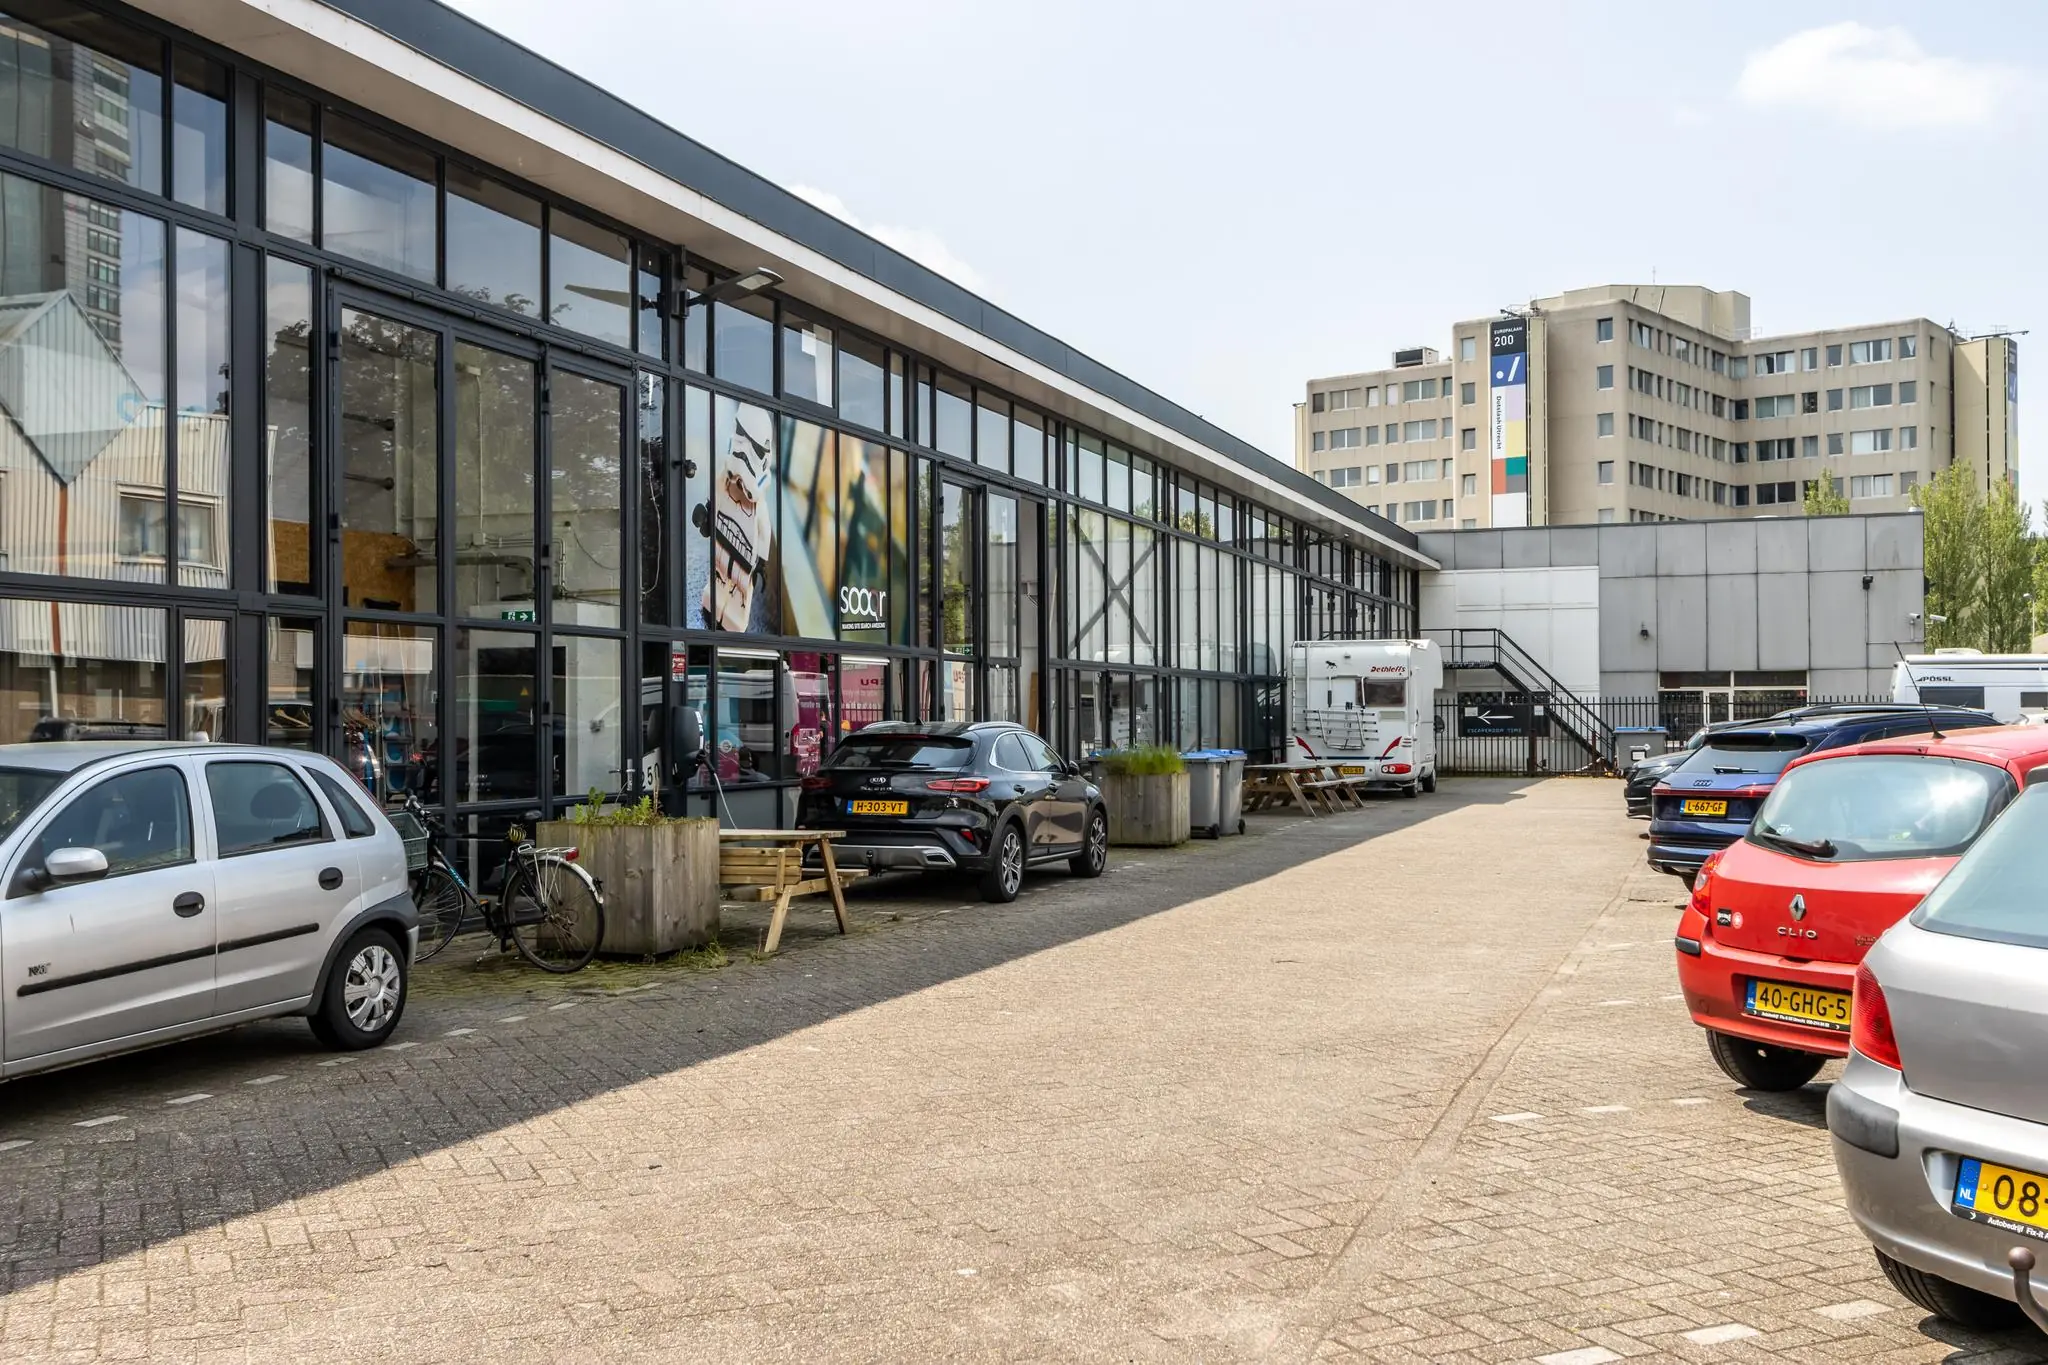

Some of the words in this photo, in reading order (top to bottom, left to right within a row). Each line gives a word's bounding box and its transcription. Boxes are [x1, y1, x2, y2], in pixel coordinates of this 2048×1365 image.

[1494, 326, 1523, 335] EUROPALAAN
[1494, 334, 1514, 347] 200
[1370, 665, 1406, 673] Dethleffs
[857, 802, 903, 812] H-303-VT
[1688, 802, 1723, 812] L-667-GF
[1777, 926, 1818, 939] CLIO
[1760, 986, 1846, 1019] 40-GHG-5
[1960, 1187, 1973, 1201] NL
[1987, 1217, 2024, 1234] Autobedrijf
